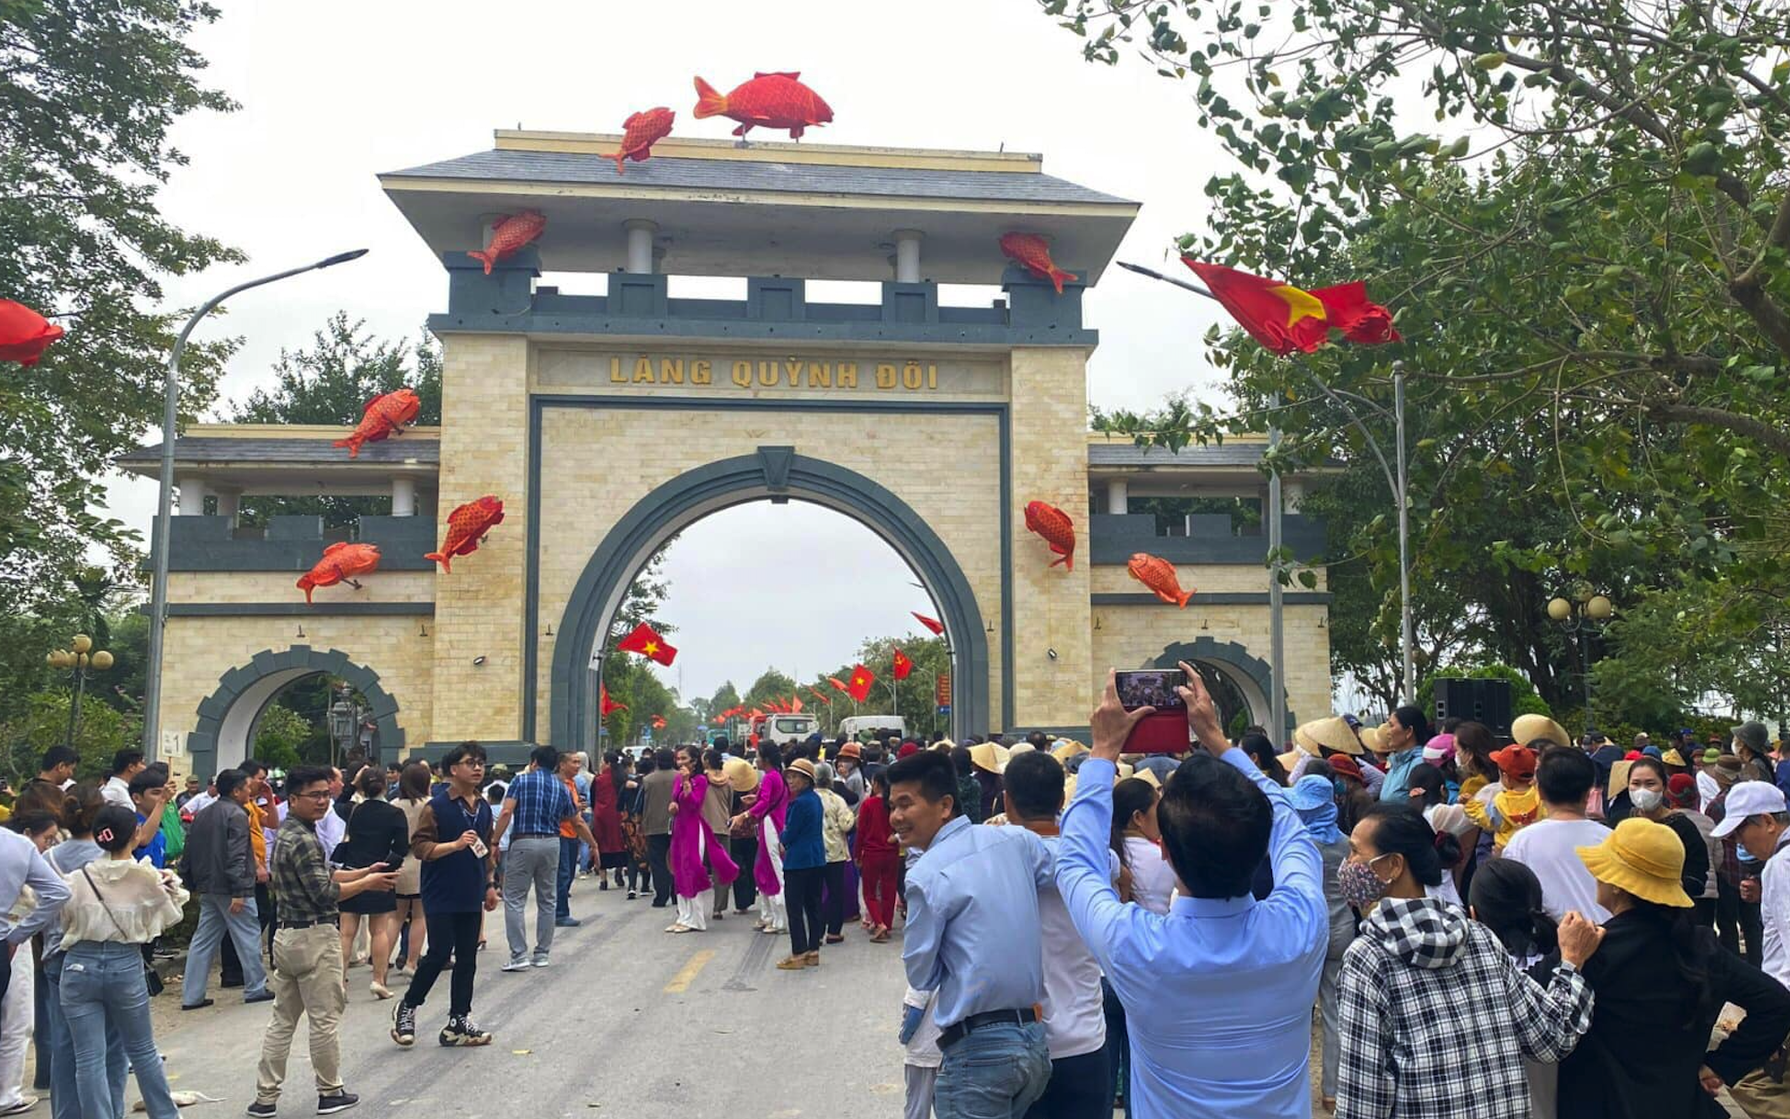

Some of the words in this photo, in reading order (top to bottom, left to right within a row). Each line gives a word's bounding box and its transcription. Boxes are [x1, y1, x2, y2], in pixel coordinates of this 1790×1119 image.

[610, 354, 712, 384] LÀNG
[732, 355, 858, 388] QUỲNH
[875, 359, 938, 389] ĐÔI
